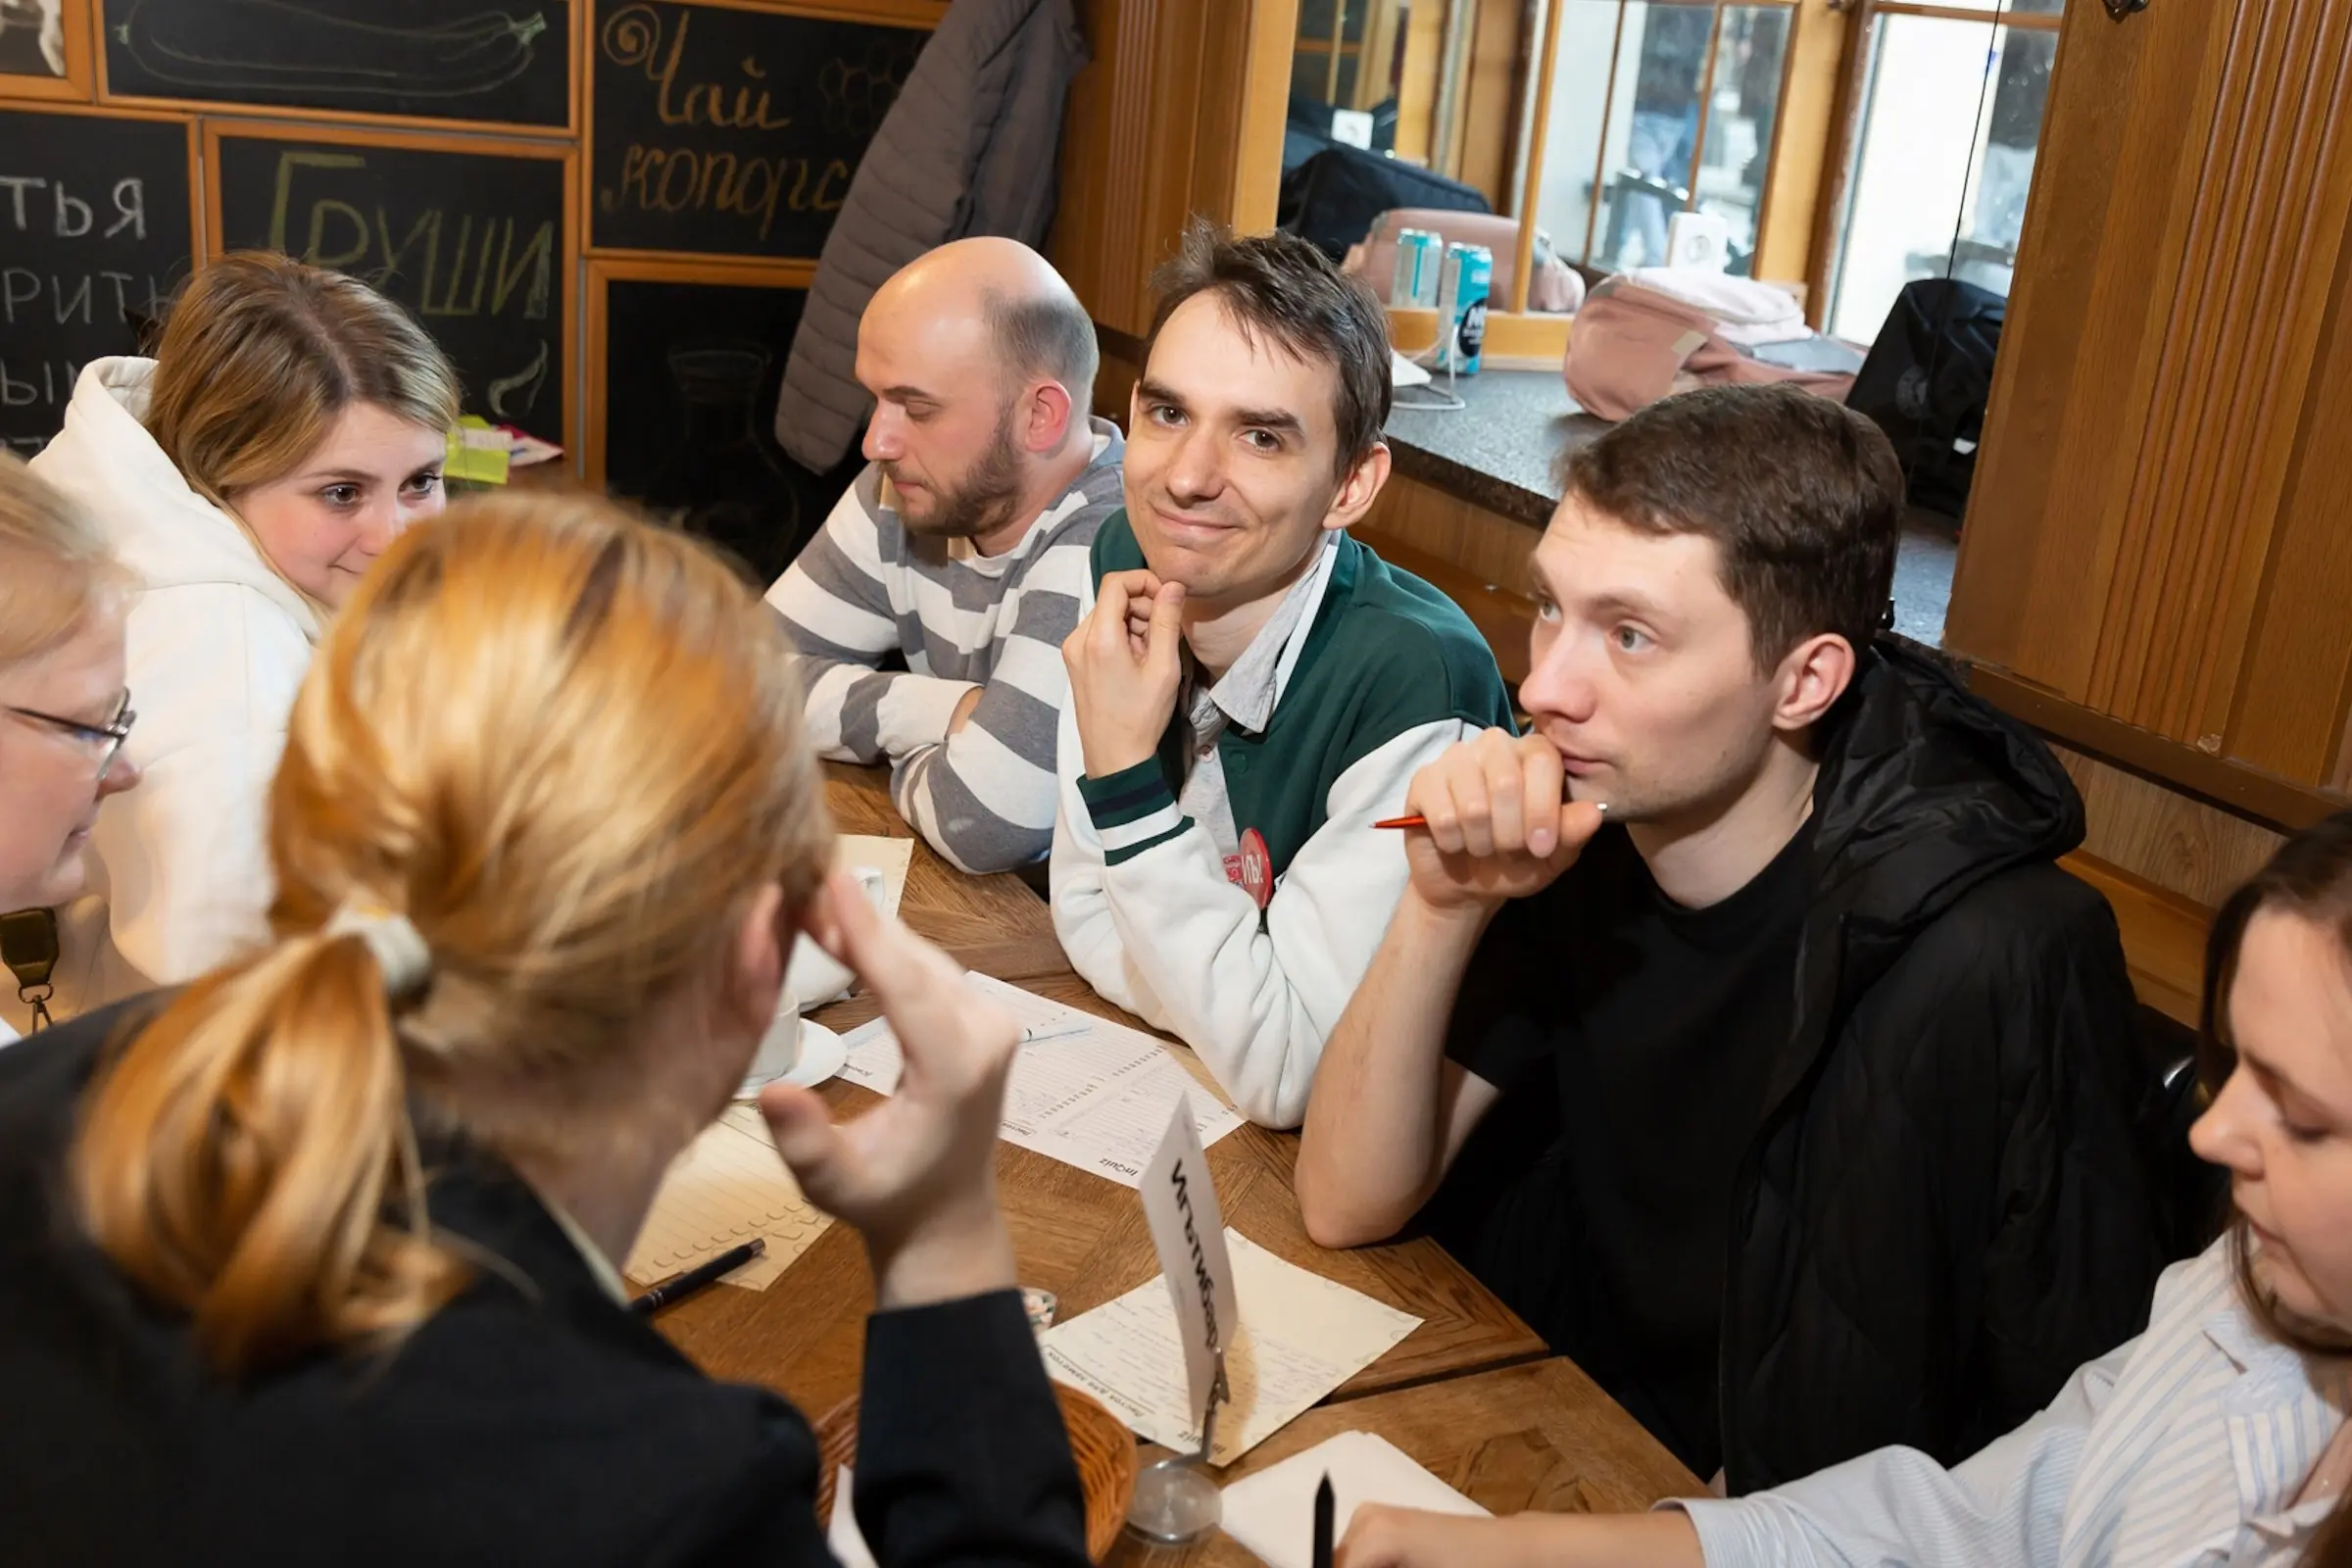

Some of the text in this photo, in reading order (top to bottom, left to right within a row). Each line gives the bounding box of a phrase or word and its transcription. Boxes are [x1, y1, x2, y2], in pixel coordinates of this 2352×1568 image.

[602, 4, 791, 130] Чай
[1099, 1157, 1139, 1177] InQuiz
[1176, 1430, 1227, 1455] Inuiz
